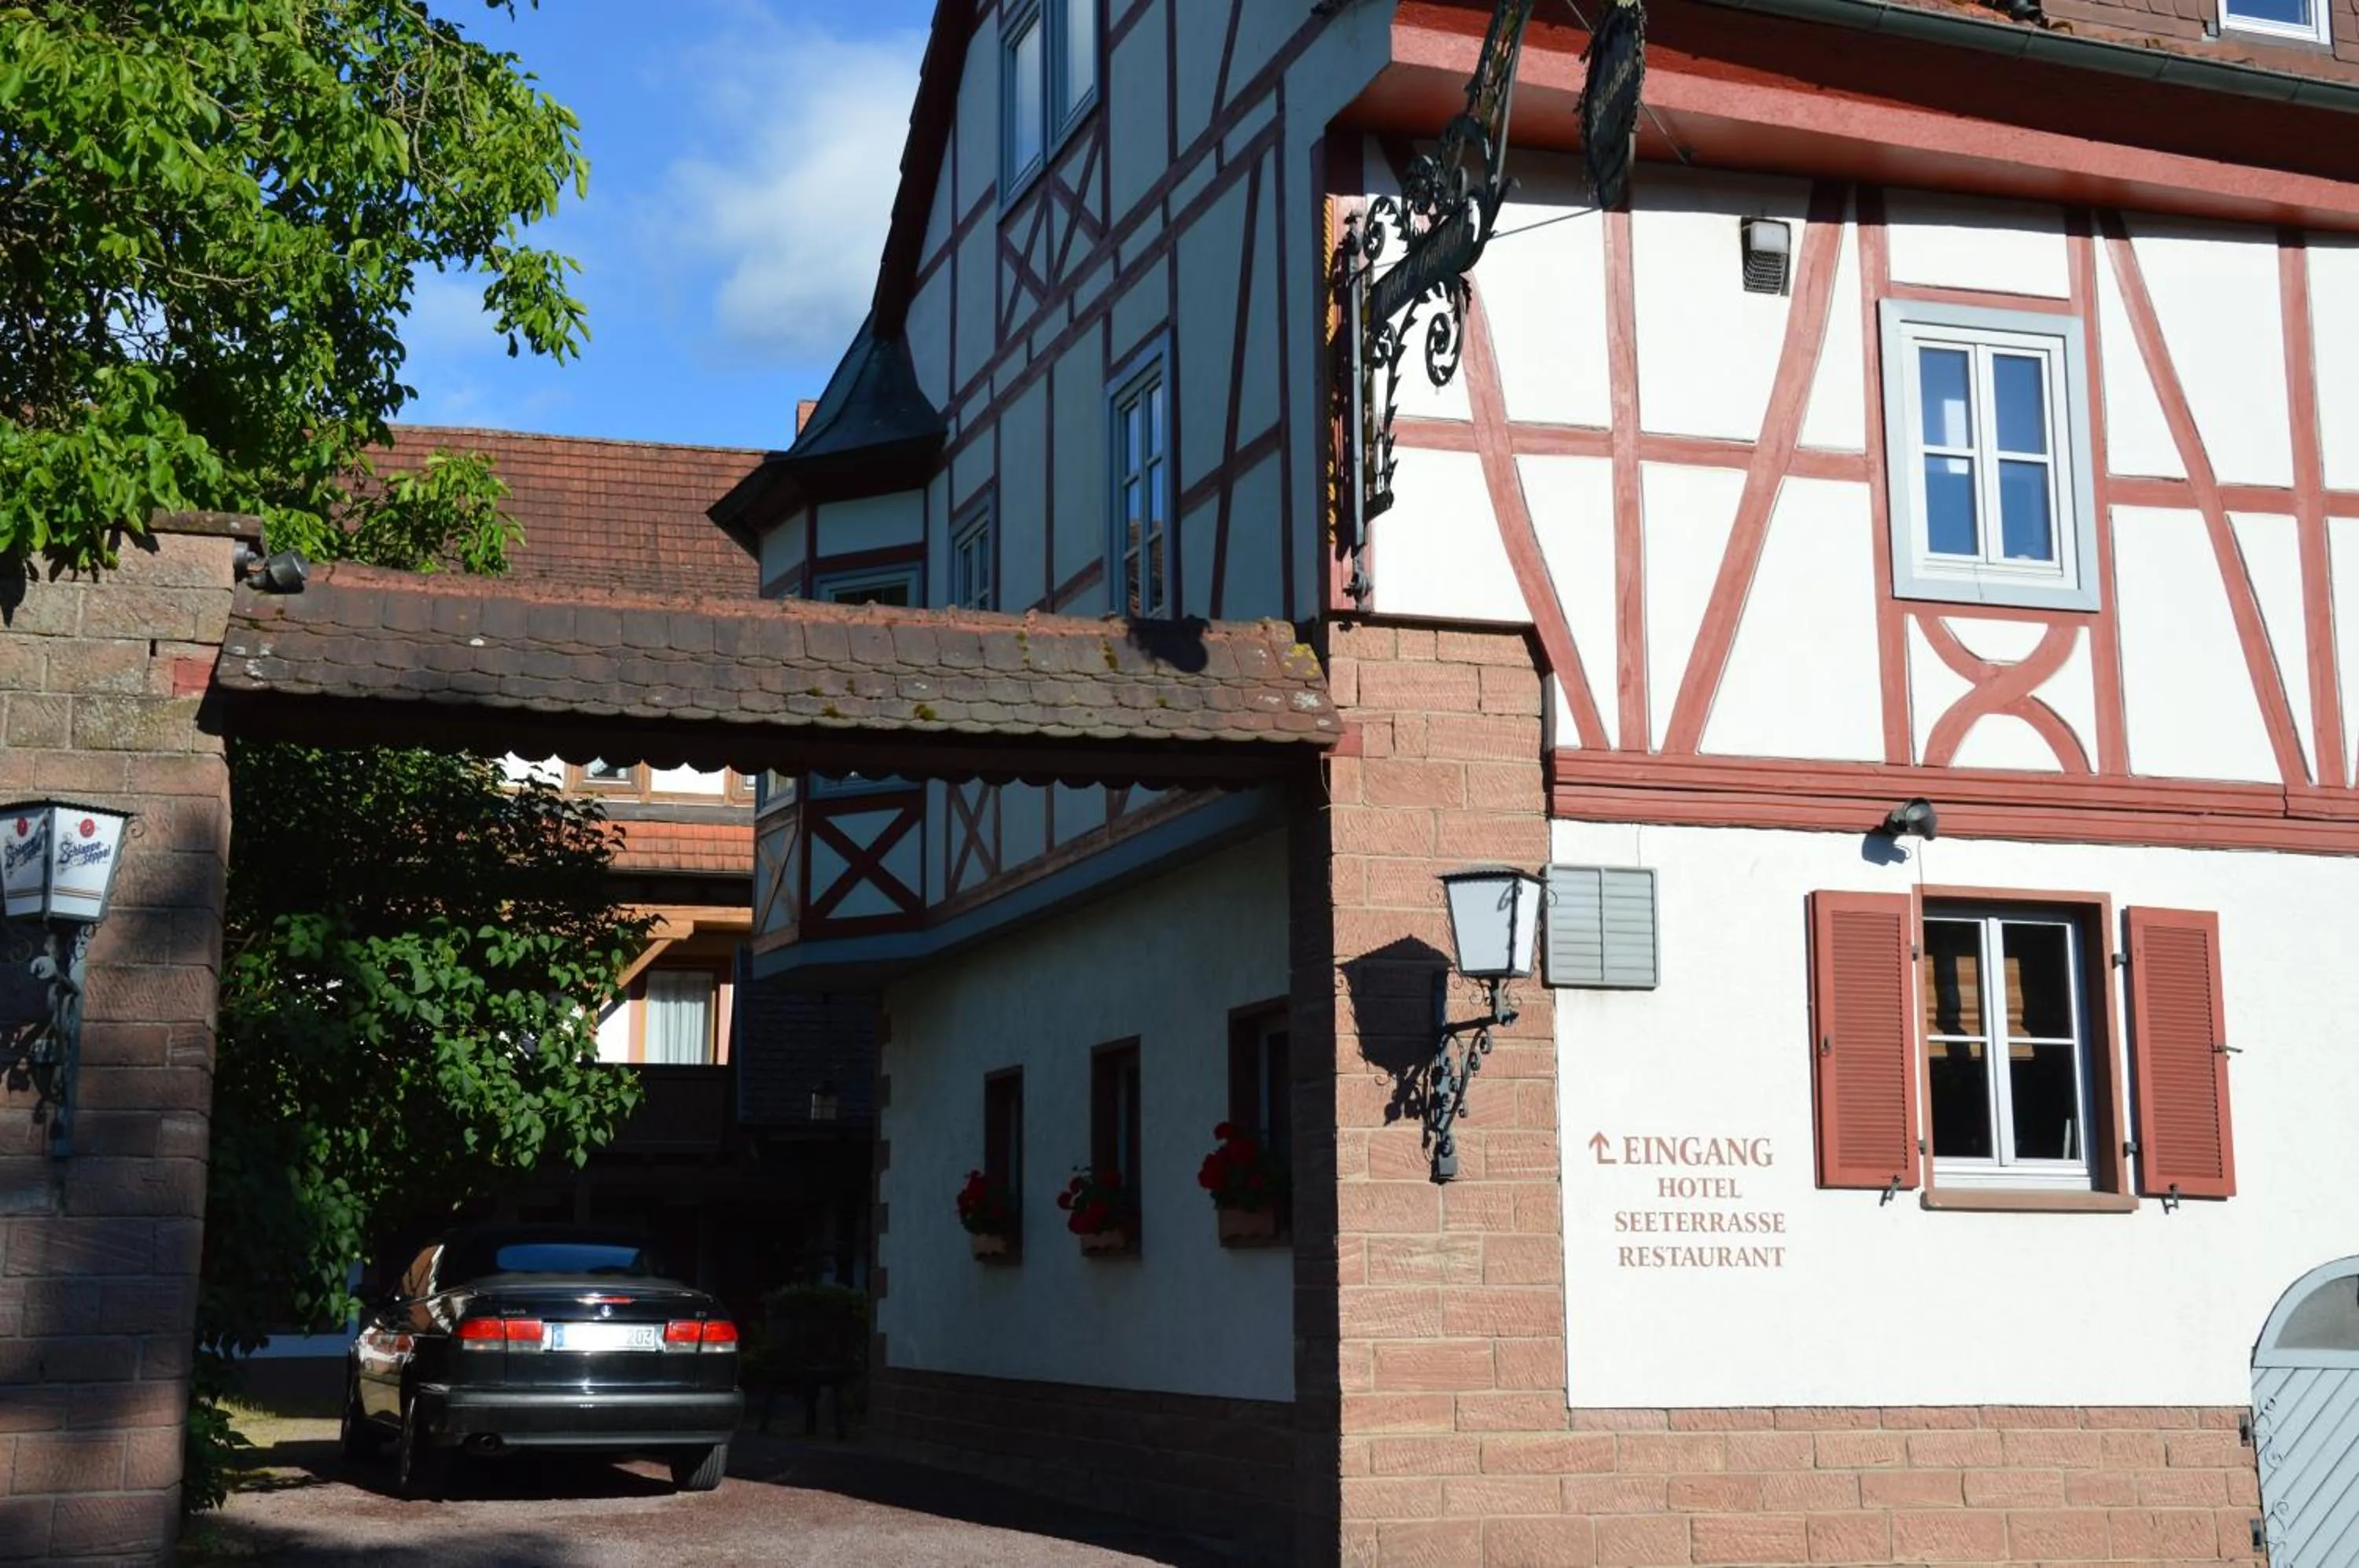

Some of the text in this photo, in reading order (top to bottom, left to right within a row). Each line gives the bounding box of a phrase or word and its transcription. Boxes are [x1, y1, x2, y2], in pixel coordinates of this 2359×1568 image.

[1622, 1136, 1774, 1168] EINGANG
[1657, 1176, 1743, 1199] HOTEL
[1614, 1211, 1787, 1234] SEETERRASSE
[1617, 1245, 1787, 1268] RESTAURANT
